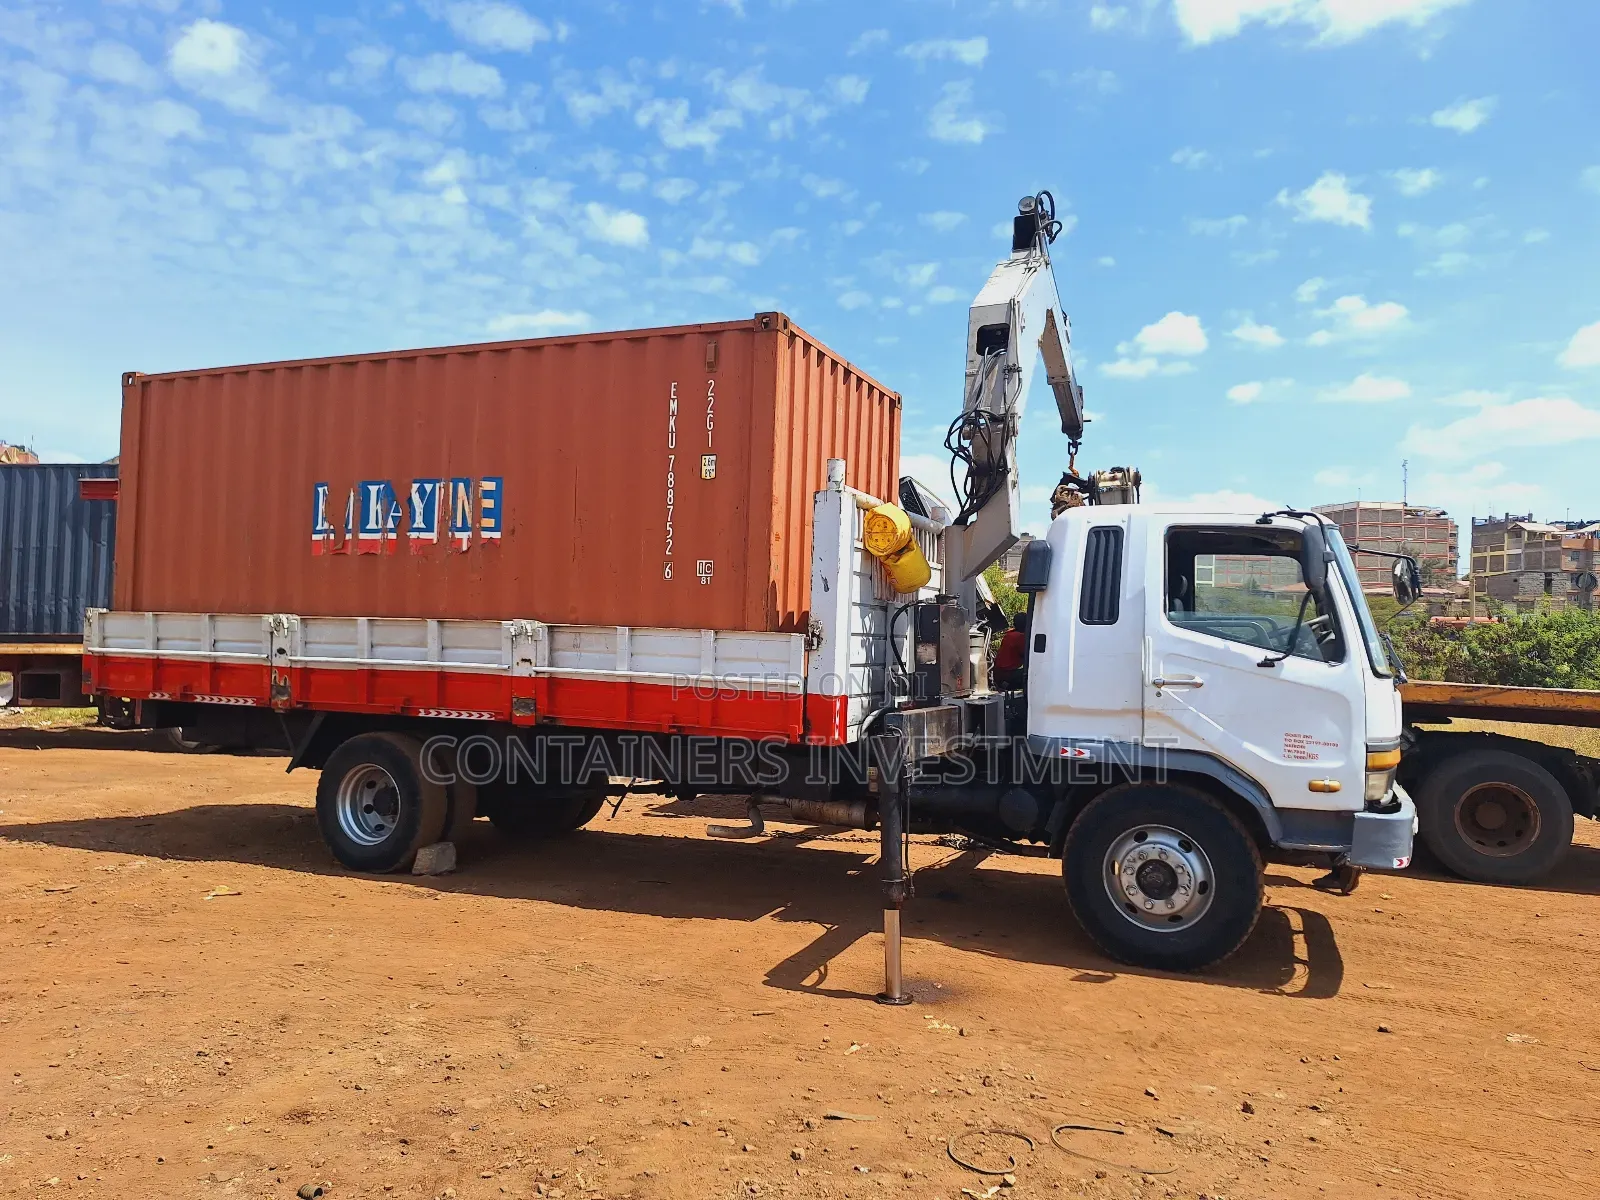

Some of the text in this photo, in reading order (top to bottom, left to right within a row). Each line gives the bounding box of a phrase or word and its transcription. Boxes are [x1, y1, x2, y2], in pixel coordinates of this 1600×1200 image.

[707, 379, 715, 448] 22G1
[664, 382, 678, 580] EMKU 788752 6
[700, 577, 711, 585] 81
